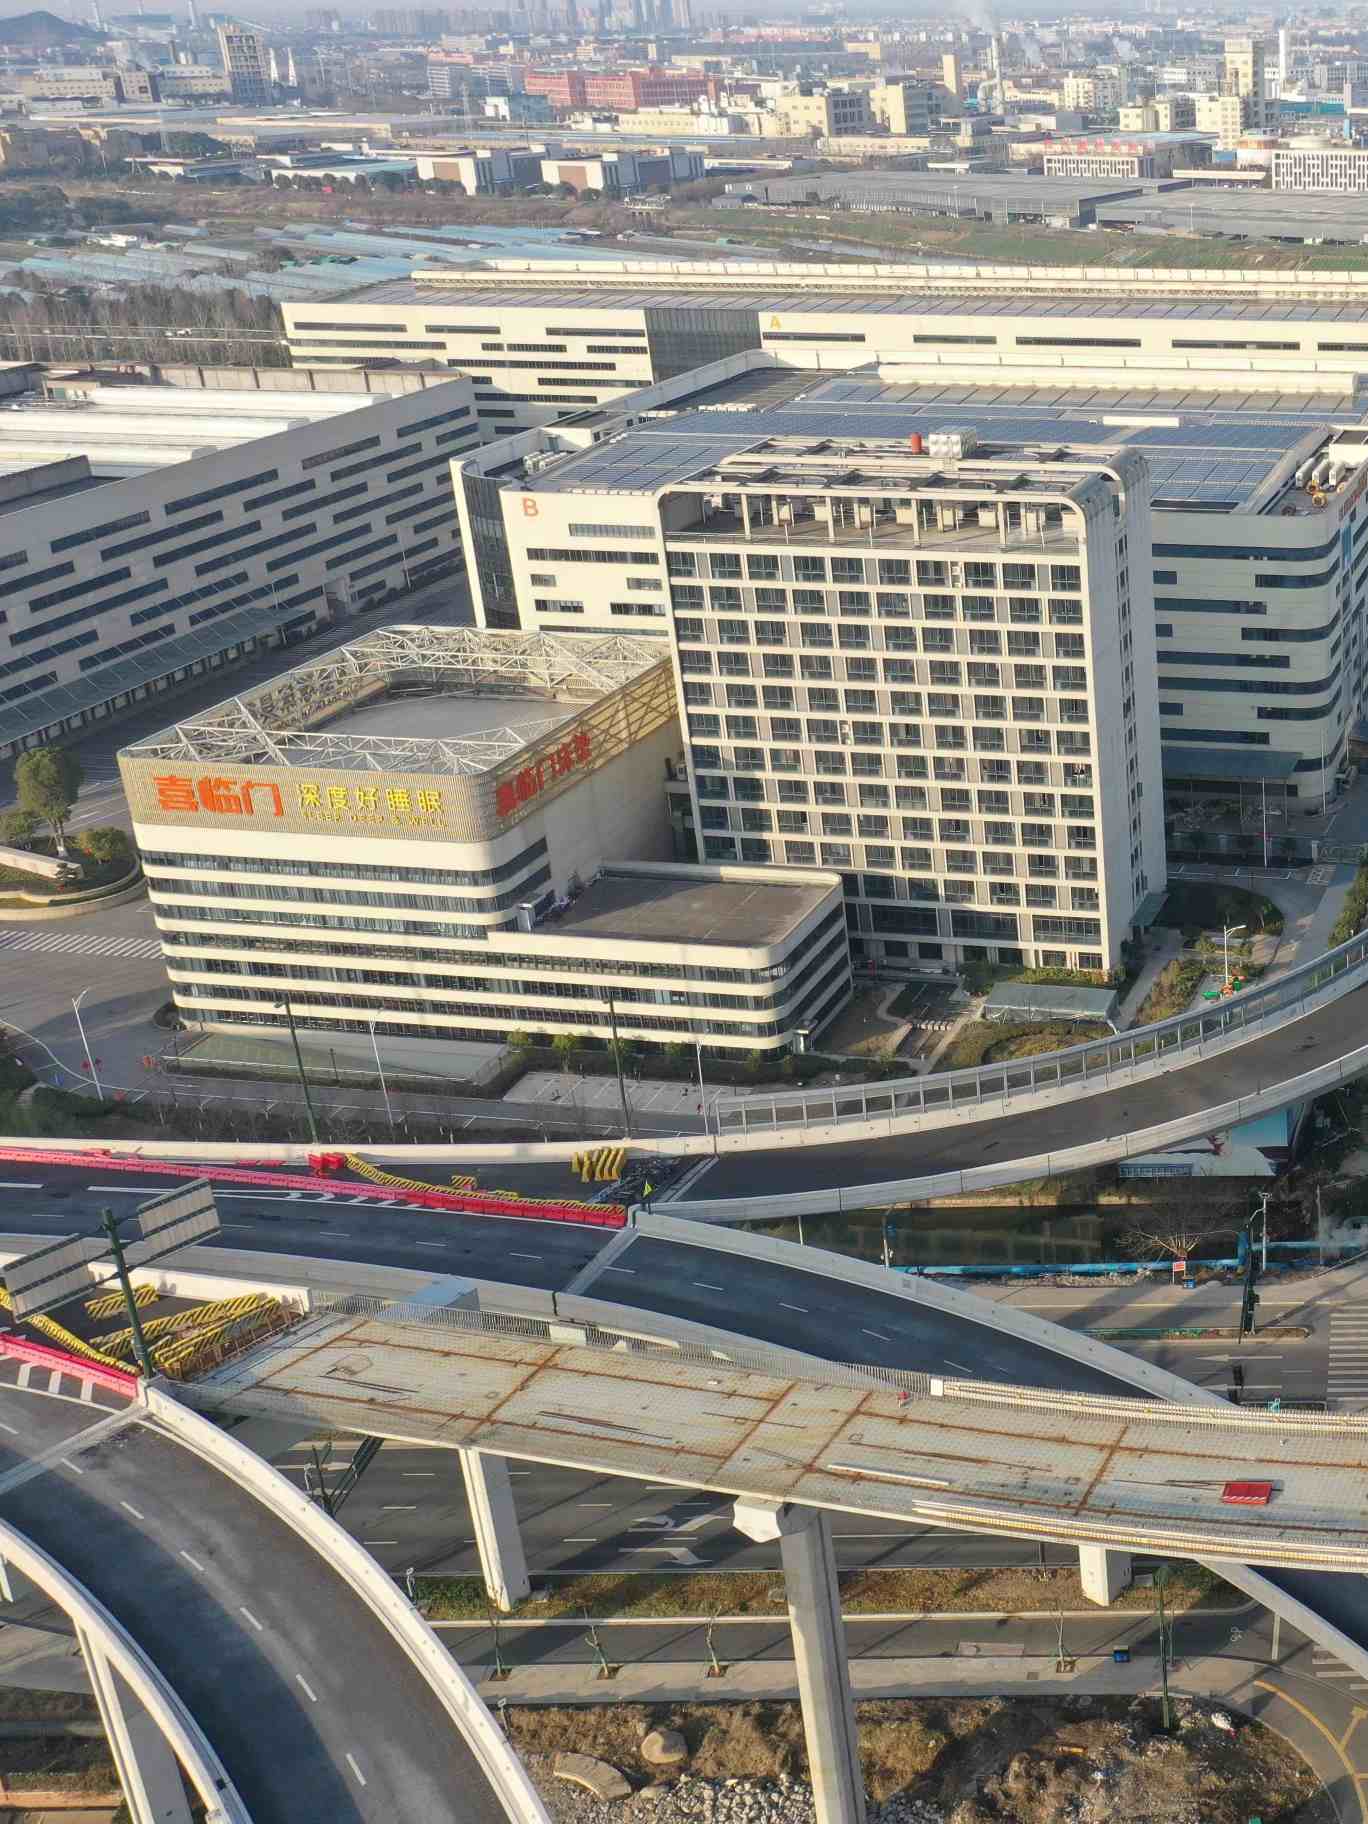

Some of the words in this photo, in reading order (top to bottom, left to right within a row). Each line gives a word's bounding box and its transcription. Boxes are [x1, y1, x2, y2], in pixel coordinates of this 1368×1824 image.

[522, 498, 538, 517] B
[153, 775, 284, 817] 喜临门
[298, 783, 444, 813] 深度好睡眠
